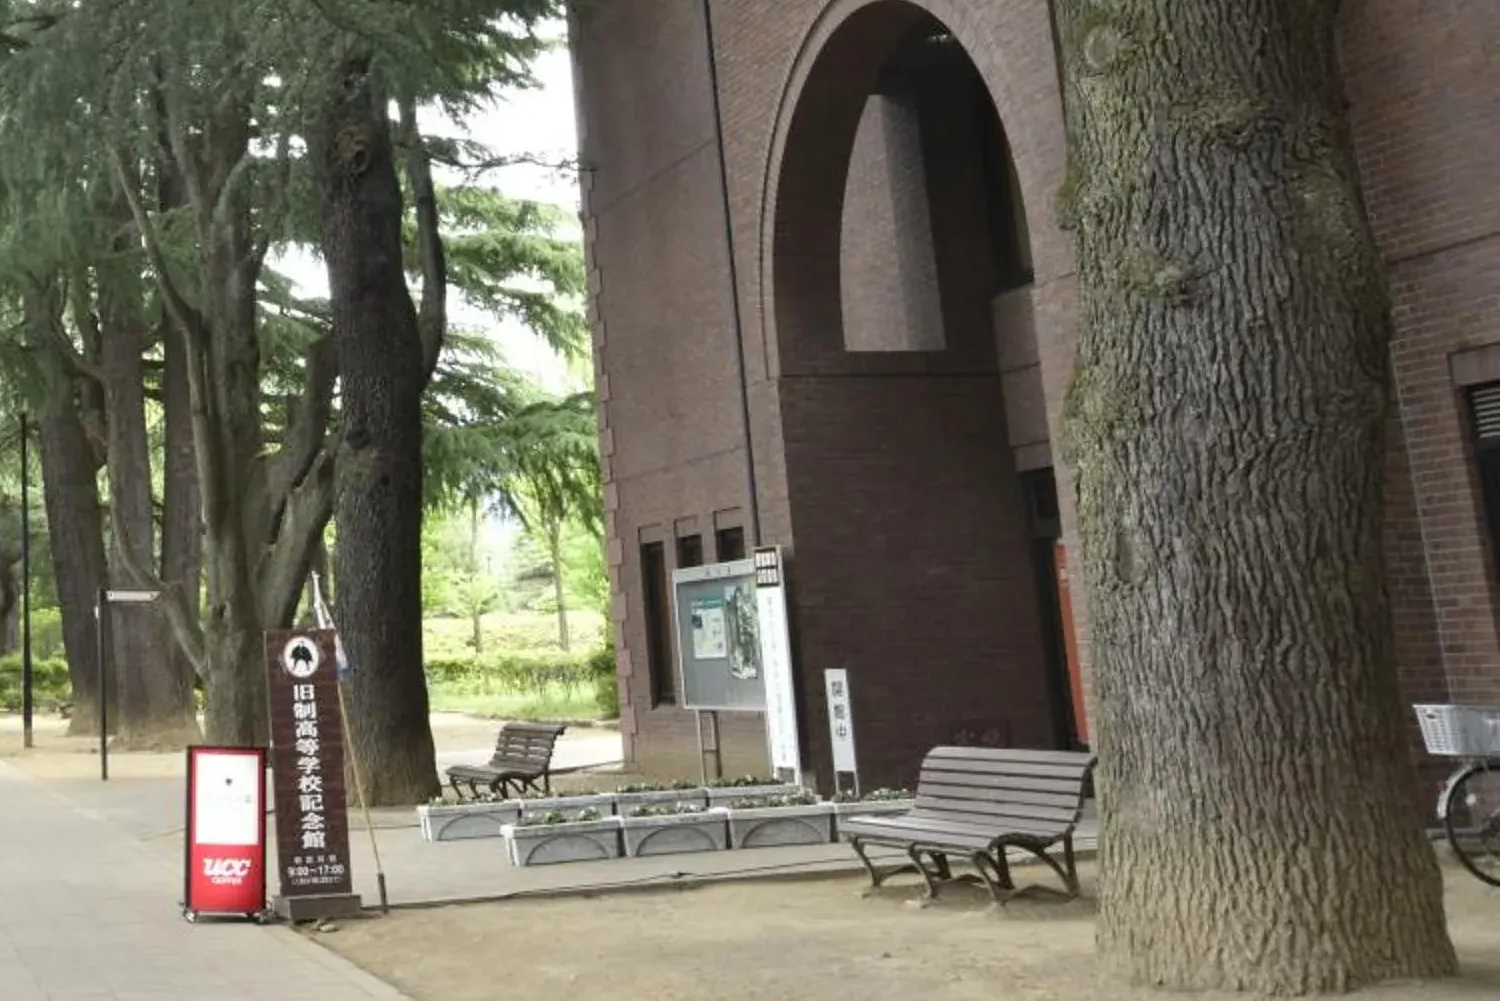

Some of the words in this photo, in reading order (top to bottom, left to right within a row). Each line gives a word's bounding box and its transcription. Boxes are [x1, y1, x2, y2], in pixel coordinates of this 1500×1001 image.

[293, 684, 326, 849] 旧制高等学校記念館
[203, 857, 252, 876] UCC
